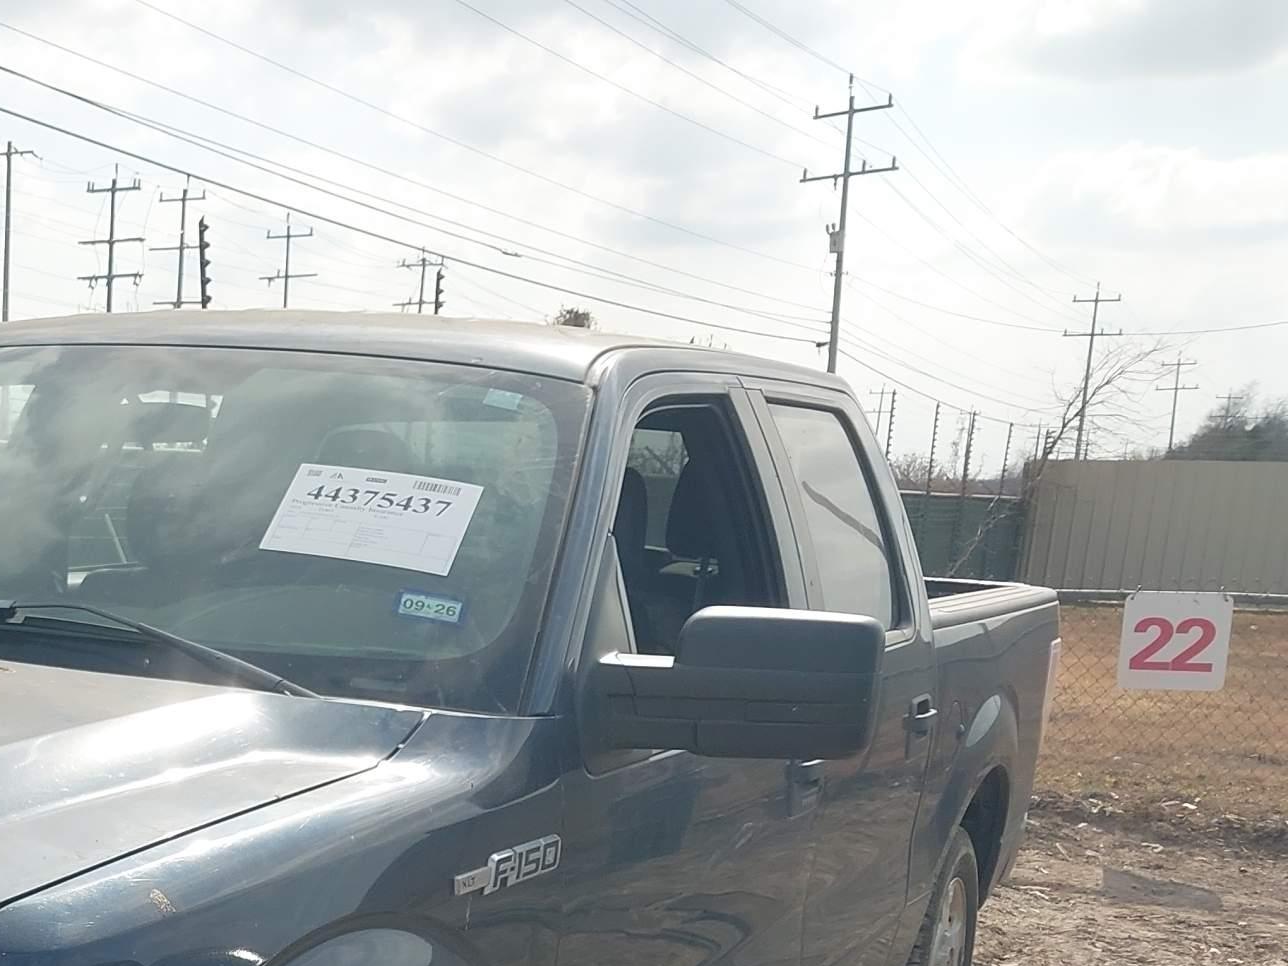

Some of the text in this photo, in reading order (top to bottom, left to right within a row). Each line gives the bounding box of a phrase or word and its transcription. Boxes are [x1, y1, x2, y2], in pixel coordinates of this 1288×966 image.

[306, 484, 453, 517] 44375437
[402, 598, 457, 617] 09 26
[1128, 616, 1216, 673] 22
[482, 833, 562, 896] F-150
